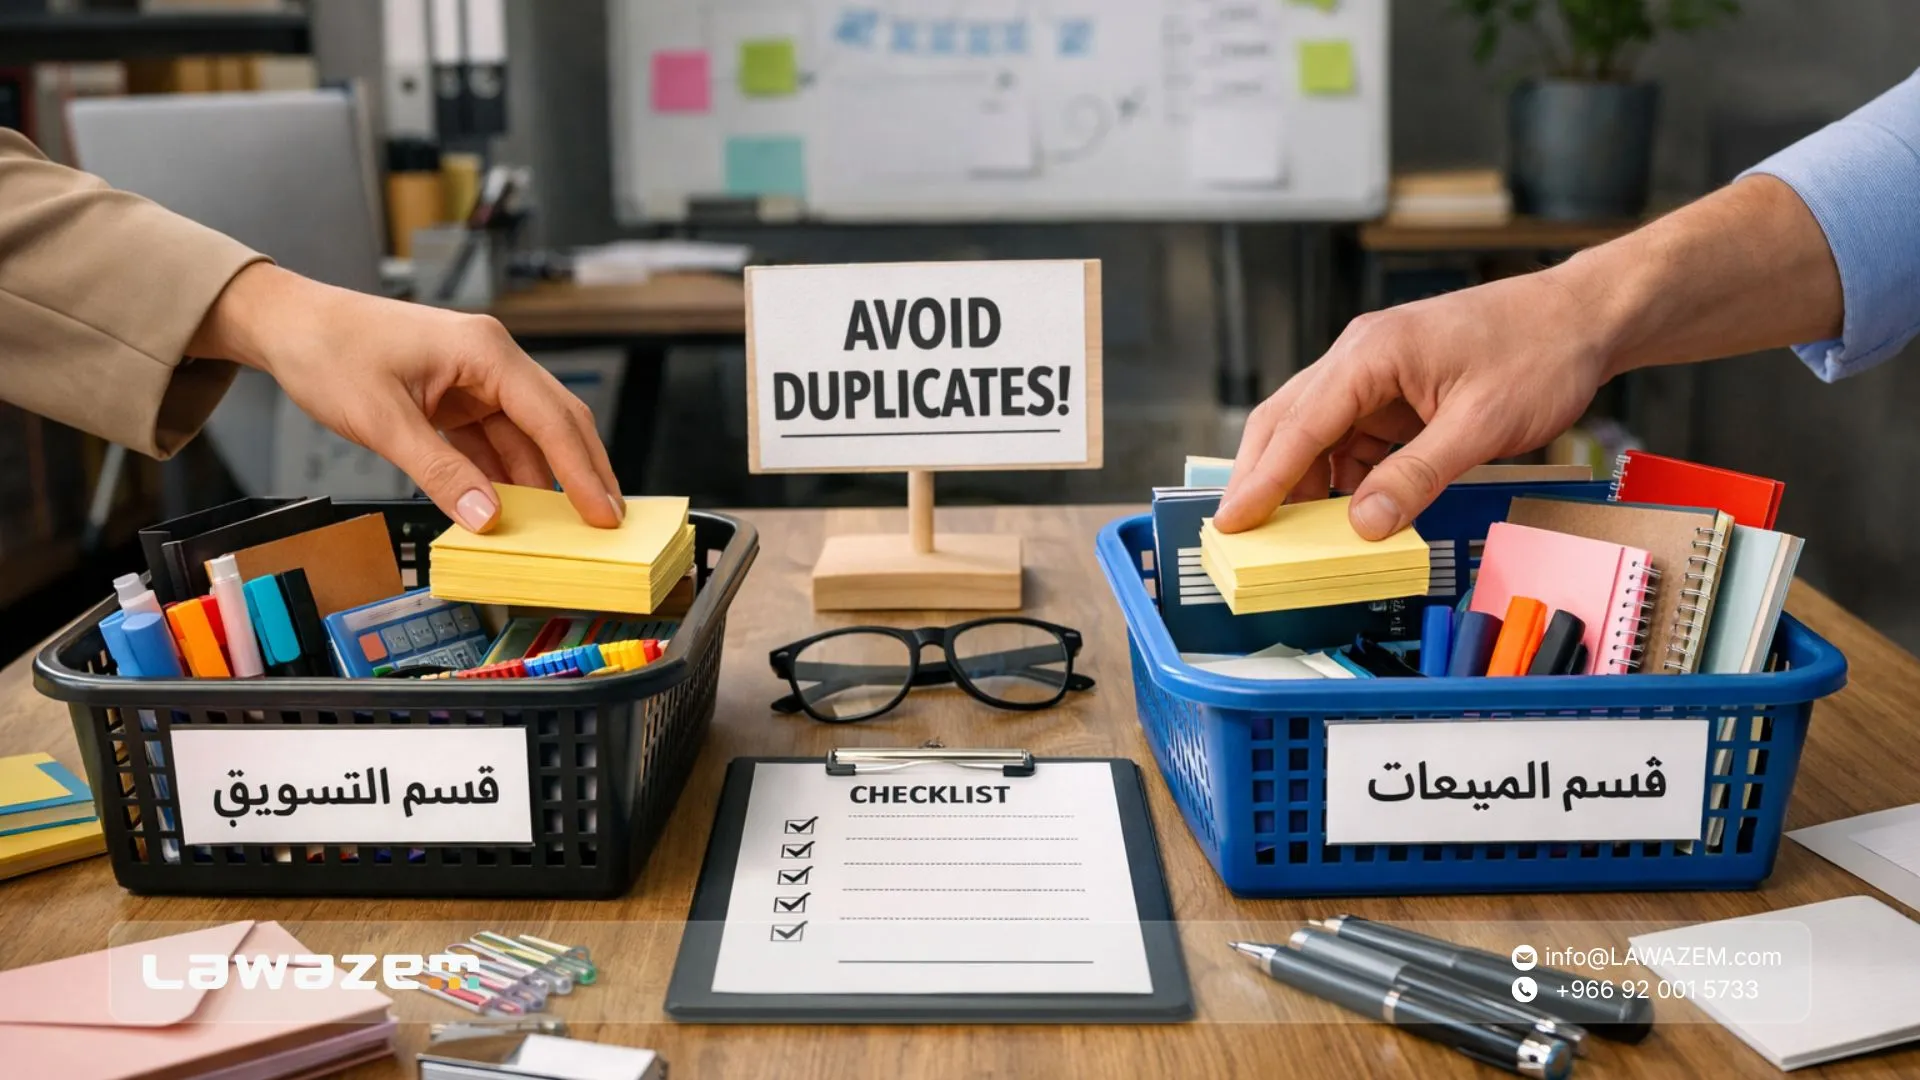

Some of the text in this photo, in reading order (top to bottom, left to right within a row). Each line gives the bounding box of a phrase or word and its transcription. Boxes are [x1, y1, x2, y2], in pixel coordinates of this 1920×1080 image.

[843, 296, 1002, 351] AVOID
[773, 365, 1071, 421] DUPLICATES!
[213, 765, 499, 828] قسم التسويق
[849, 785, 1011, 804] CHECKLIST
